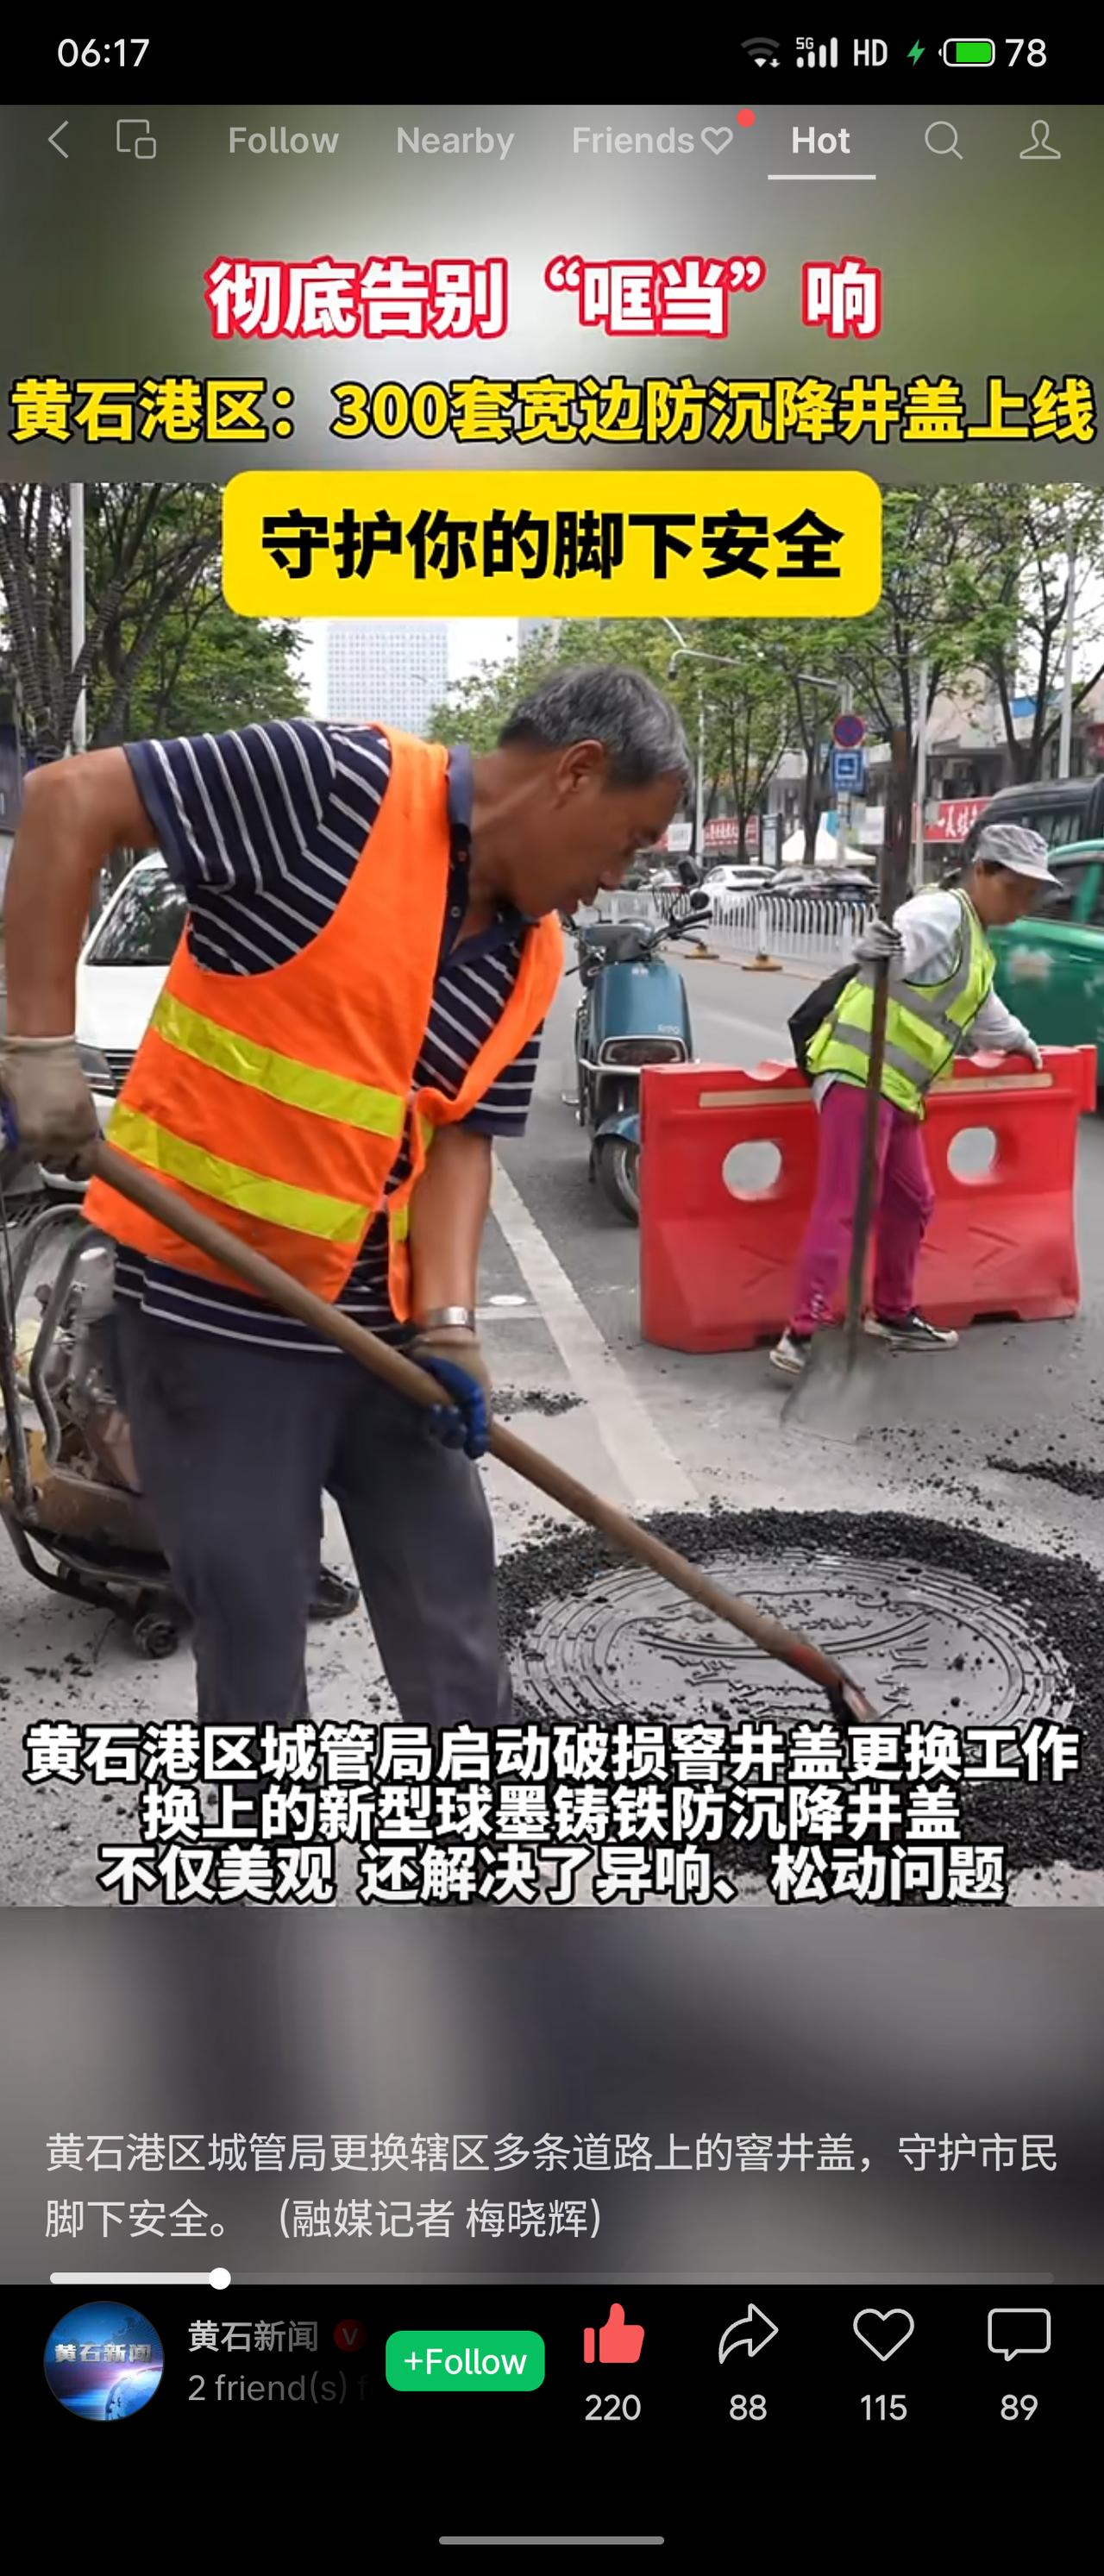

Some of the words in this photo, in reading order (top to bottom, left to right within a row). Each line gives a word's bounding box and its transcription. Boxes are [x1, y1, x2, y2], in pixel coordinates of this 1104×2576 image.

[57, 38, 150, 67] 06:17
[795, 36, 814, 50] 5G
[853, 38, 888, 66] HD
[1005, 38, 1047, 67] 78
[228, 126, 340, 154] Follow
[396, 126, 516, 160] Nearby
[572, 126, 695, 154] Friends
[792, 126, 851, 154] Hot
[45, 2132, 1057, 2172] 黄石港区城管局更换辖区多条道路上的窨井盖，守护市民
[187, 2320, 318, 2353] 黄石新闻
[54, 2343, 153, 2364] 黄石新闻
[404, 2347, 528, 2376] +Follow
[188, 2374, 206, 2401] 2
[215, 2371, 347, 2404] friend(s)
[585, 2394, 642, 2421] 220
[729, 2394, 768, 2421] 88
[861, 2394, 907, 2421] 115
[1000, 2394, 1038, 2421] 89
